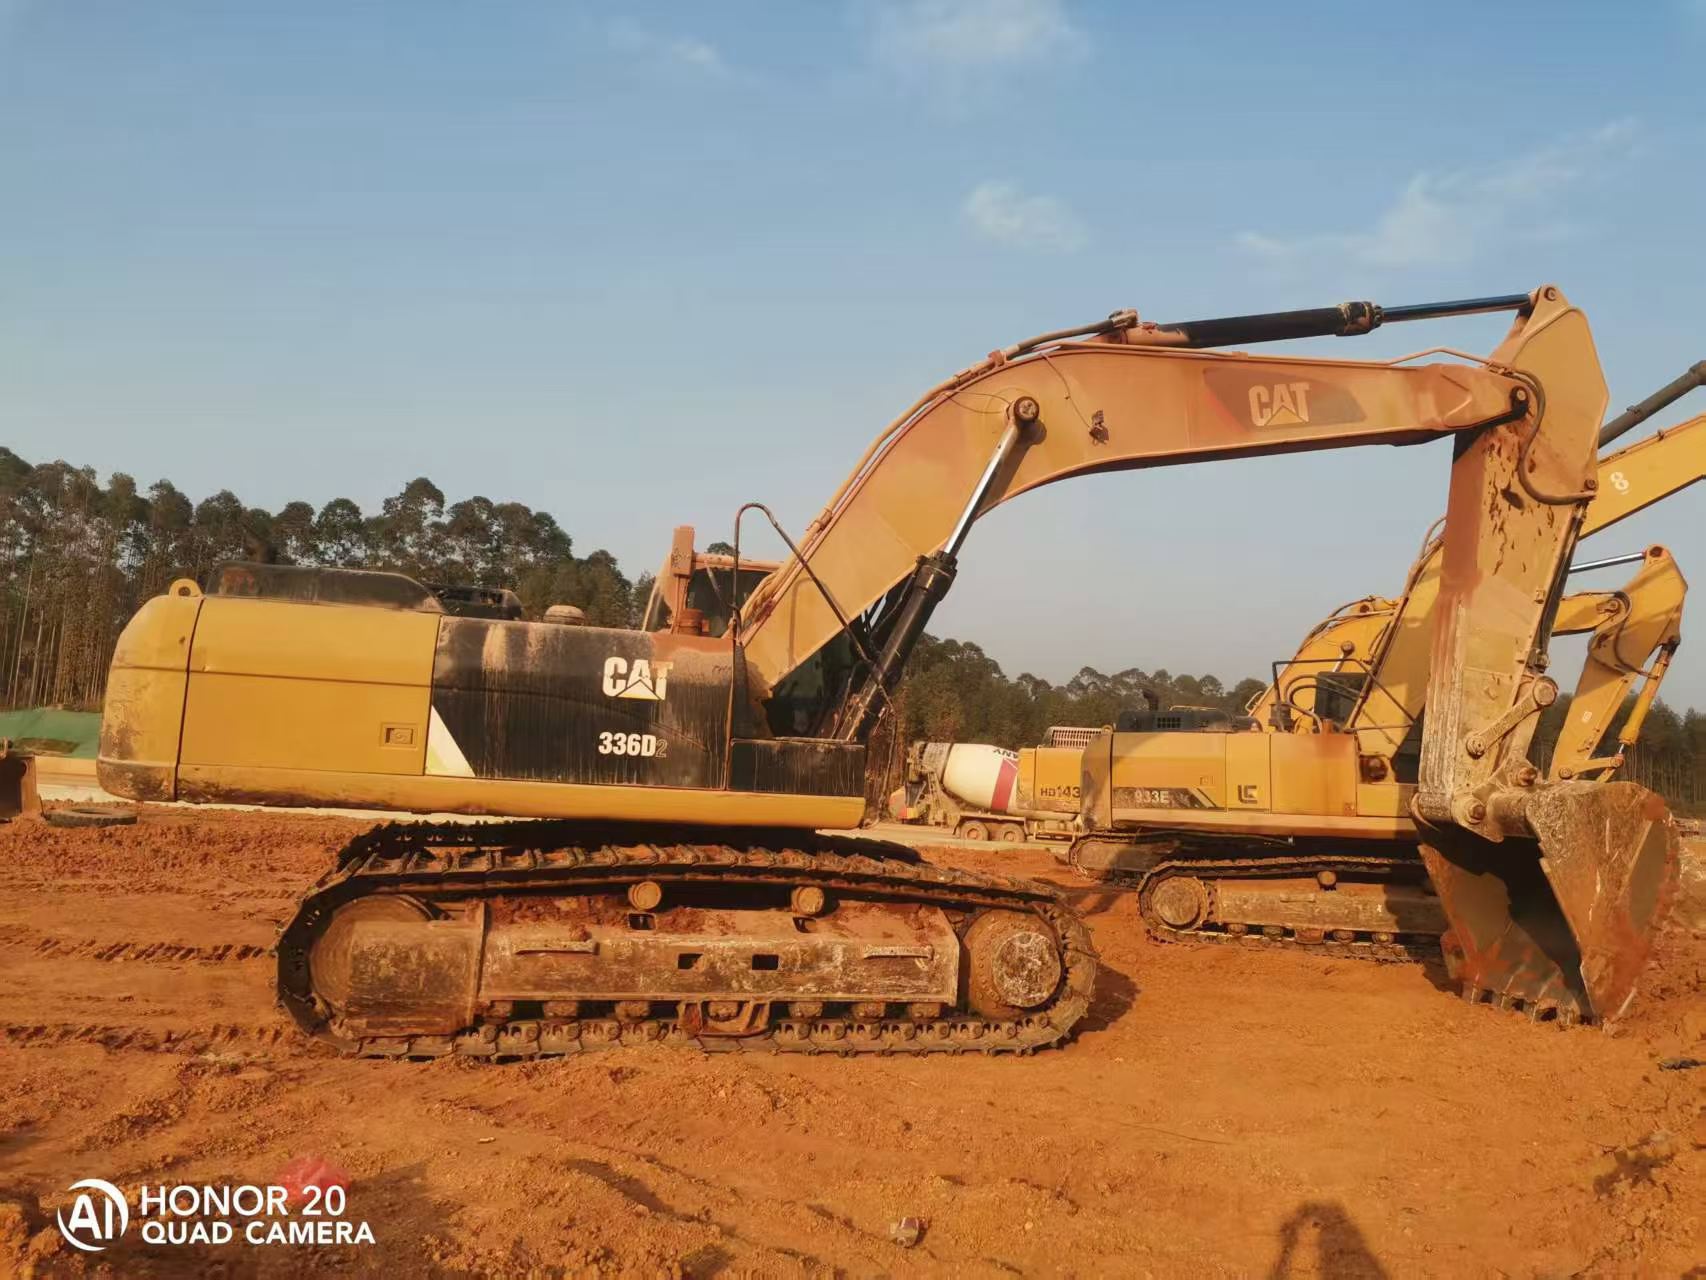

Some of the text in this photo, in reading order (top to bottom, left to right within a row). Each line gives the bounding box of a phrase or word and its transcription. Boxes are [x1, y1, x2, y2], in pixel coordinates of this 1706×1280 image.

[1248, 382, 1310, 427] CAT
[602, 656, 674, 701] CAT
[598, 731, 668, 758] 336D2
